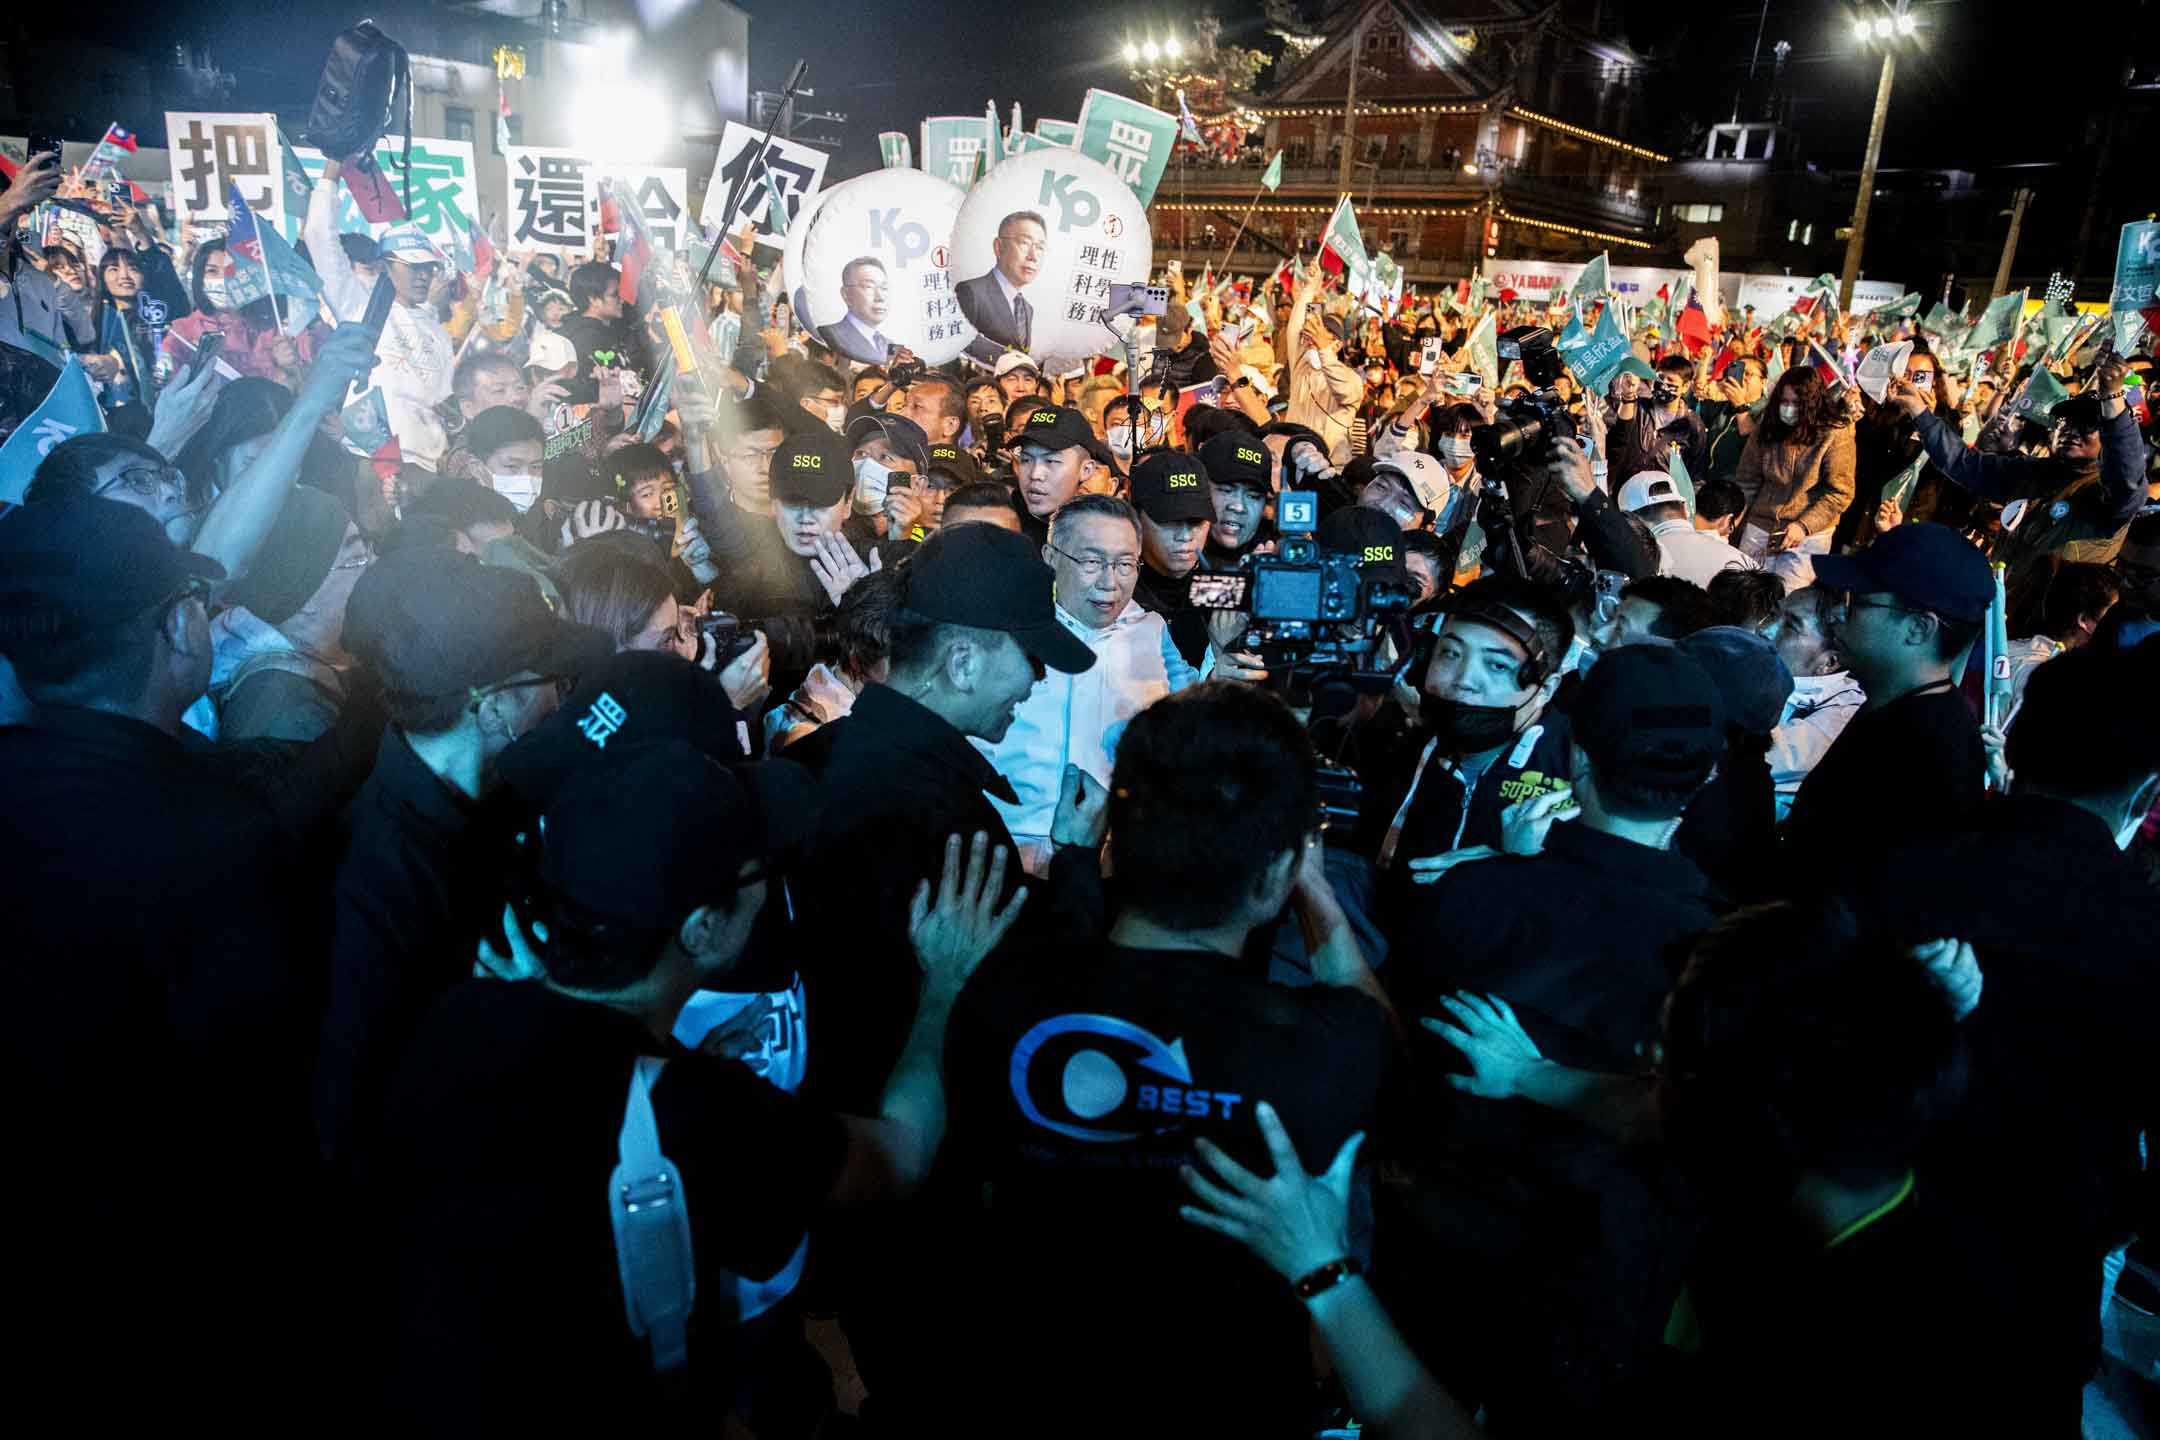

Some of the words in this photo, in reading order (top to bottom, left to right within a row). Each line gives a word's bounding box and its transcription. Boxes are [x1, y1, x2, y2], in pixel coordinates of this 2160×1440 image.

[179, 120, 272, 211] 把
[721, 137, 816, 236] 你
[1079, 245, 1120, 270] 理性
[1032, 412, 1057, 424] SSC
[792, 455, 822, 469] SSC
[932, 448, 956, 460] SSC
[1237, 447, 1262, 465] SSC
[1168, 472, 1198, 489] SSC
[1364, 546, 1393, 562] SSC
[1137, 1084, 1243, 1121] BEST
